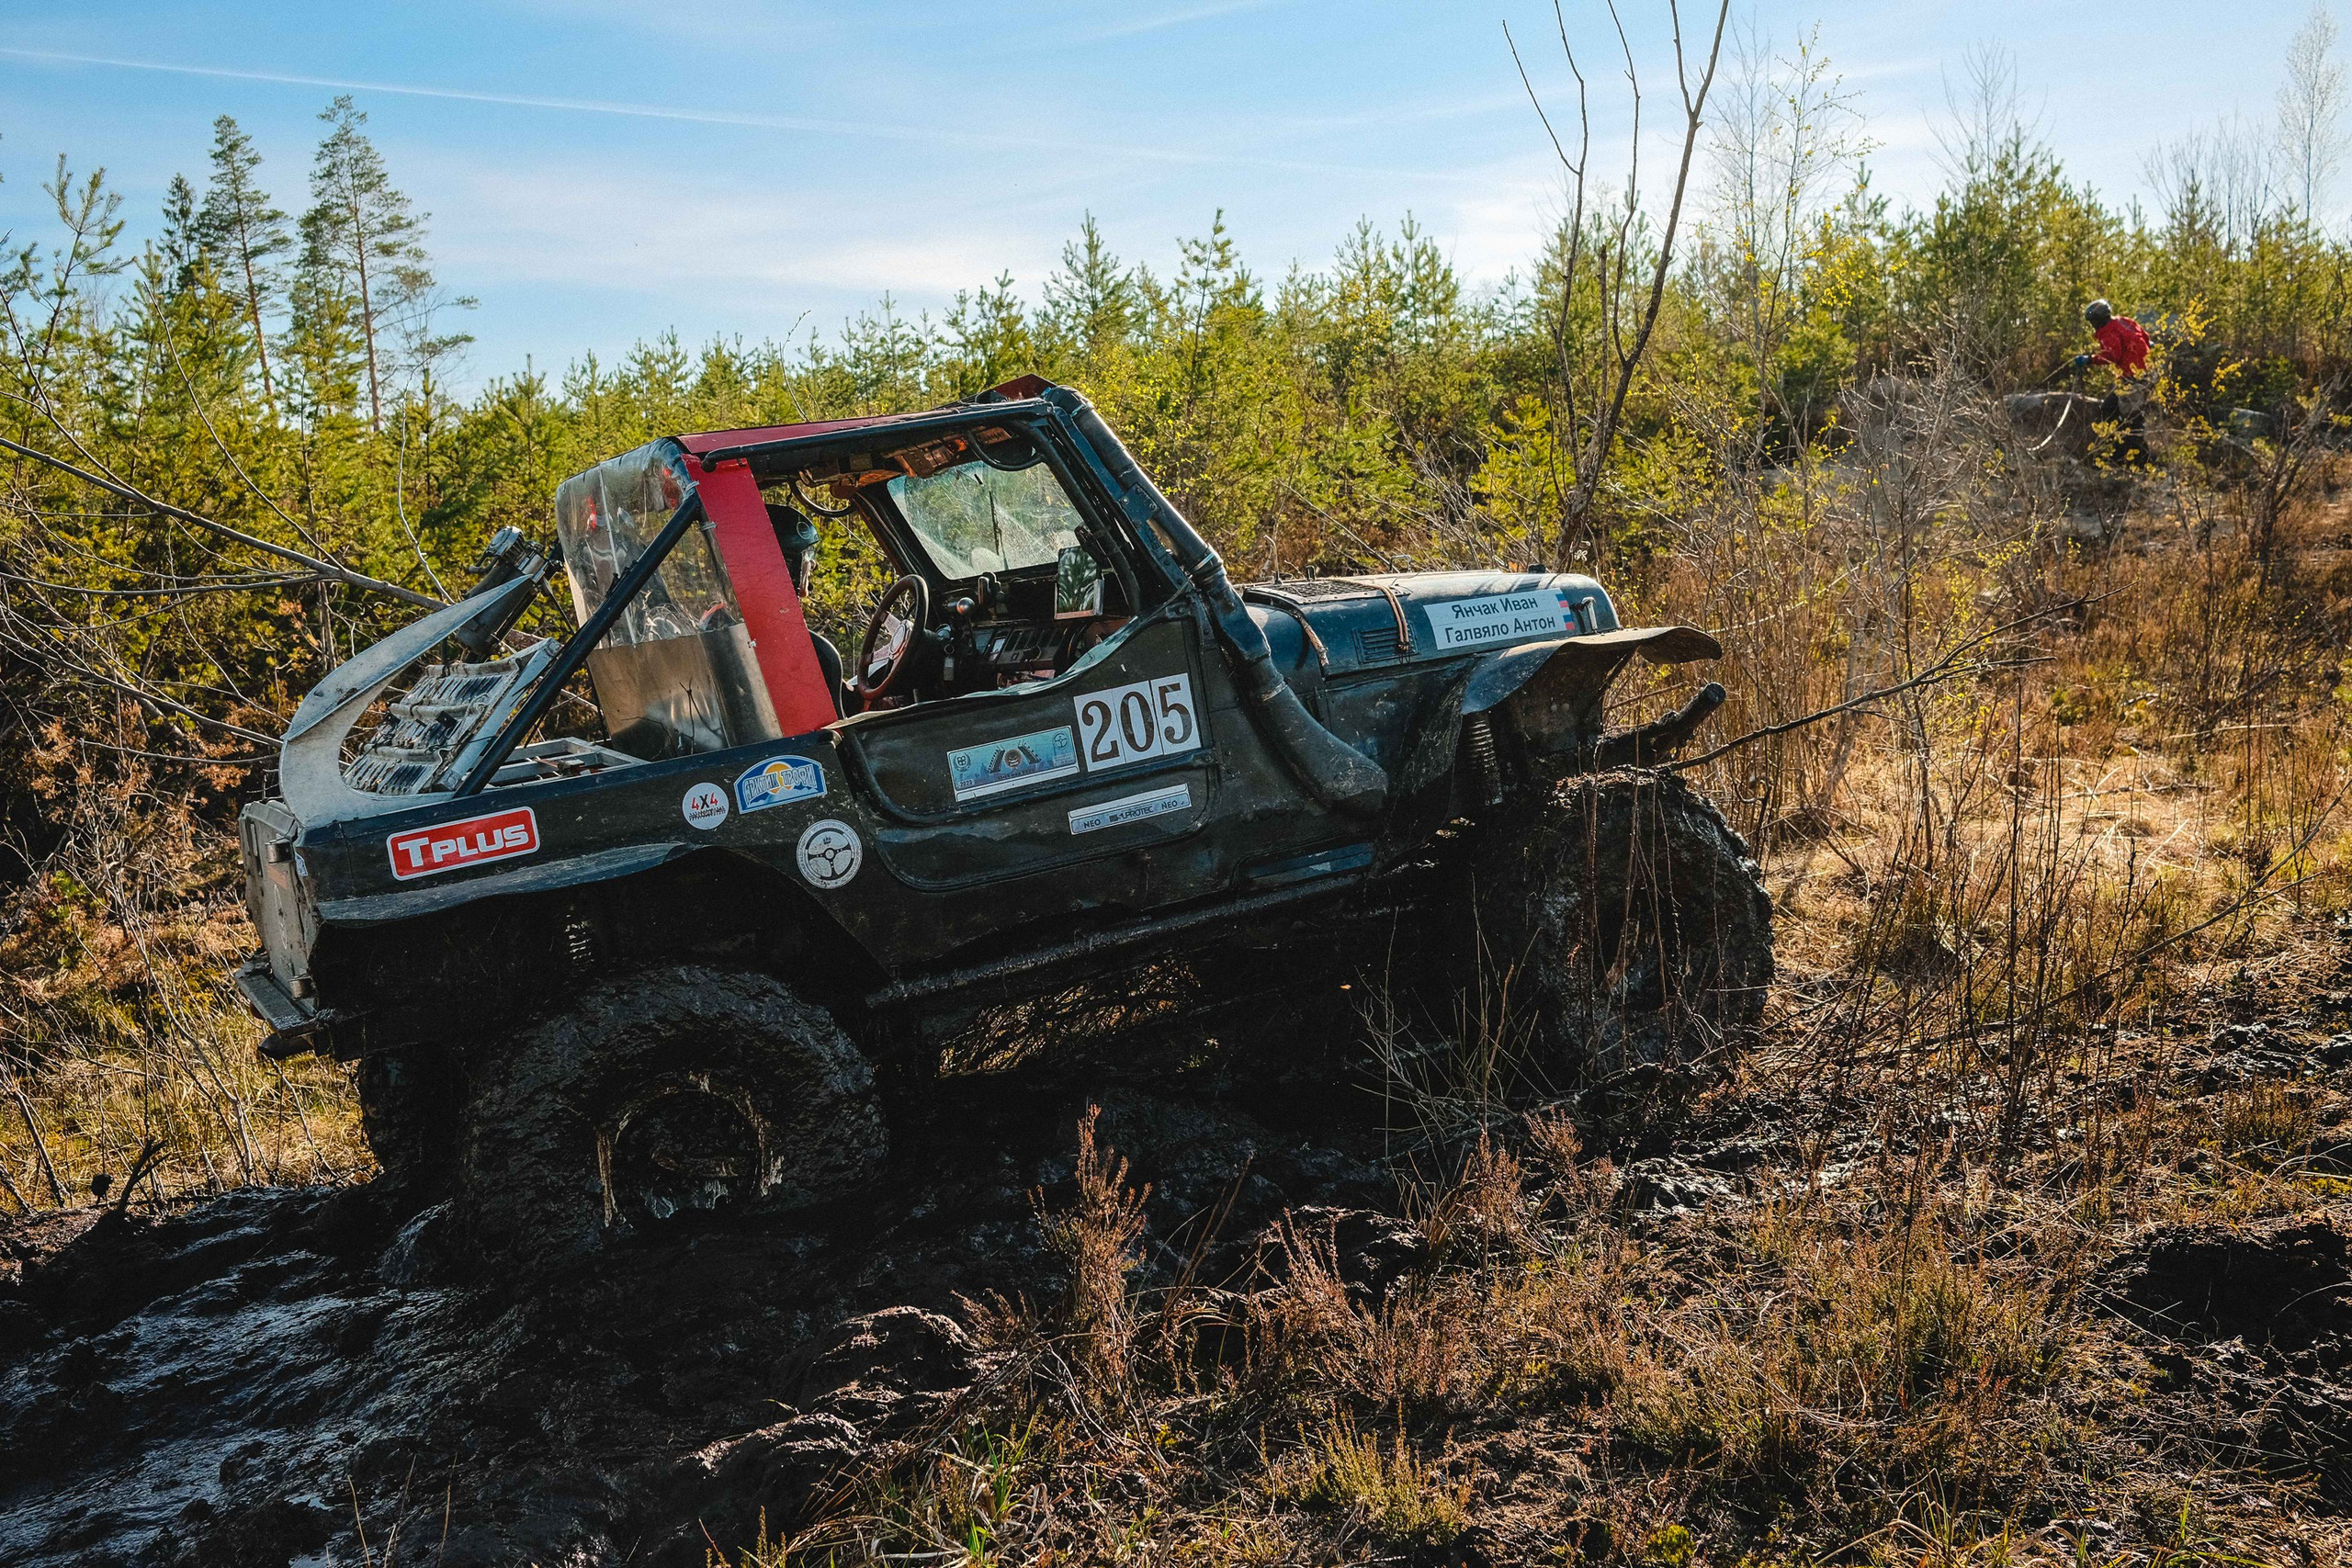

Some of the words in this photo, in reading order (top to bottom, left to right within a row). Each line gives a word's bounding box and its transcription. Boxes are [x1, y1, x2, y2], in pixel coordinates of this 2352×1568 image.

[1451, 601, 1500, 619] Янчак
[1499, 597, 1539, 613] Иван
[1444, 622, 1510, 644] Галвяло
[1513, 615, 1555, 634] Антон
[1081, 682, 1193, 763] 205
[1160, 800, 1179, 810] NEO
[1083, 818, 1102, 829] NEO
[398, 824, 529, 868] TPLUS
